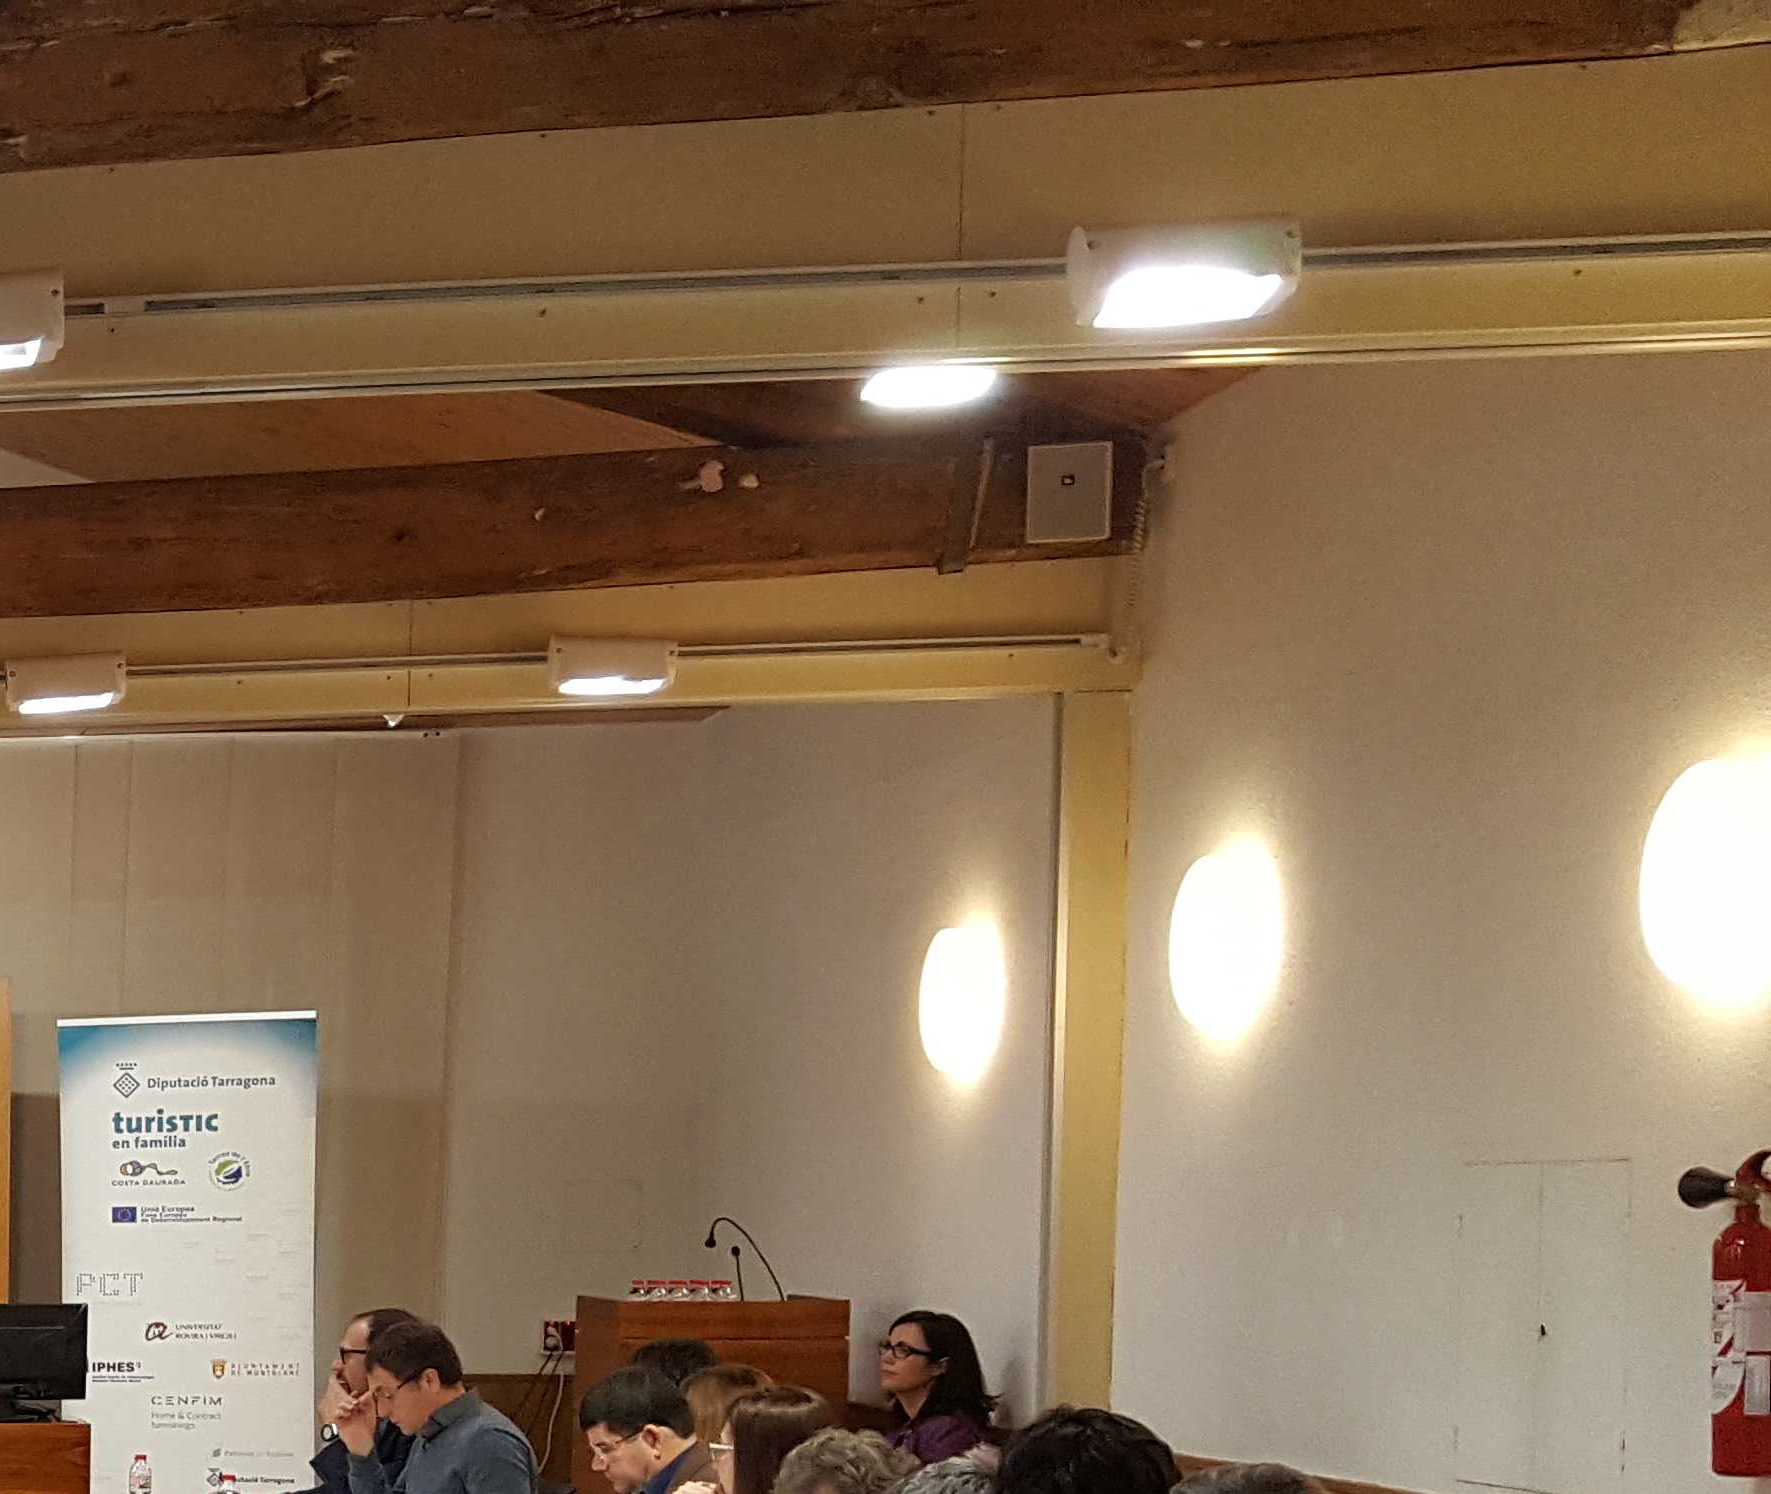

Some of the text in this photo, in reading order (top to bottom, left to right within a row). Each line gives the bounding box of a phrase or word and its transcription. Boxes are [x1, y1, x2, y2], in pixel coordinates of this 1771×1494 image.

[147, 1076, 276, 1092] Diputació Tarragona
[112, 1135, 187, 1149] en família
[92, 1362, 135, 1373] IPHES
[151, 1396, 223, 1406] CENFIM
